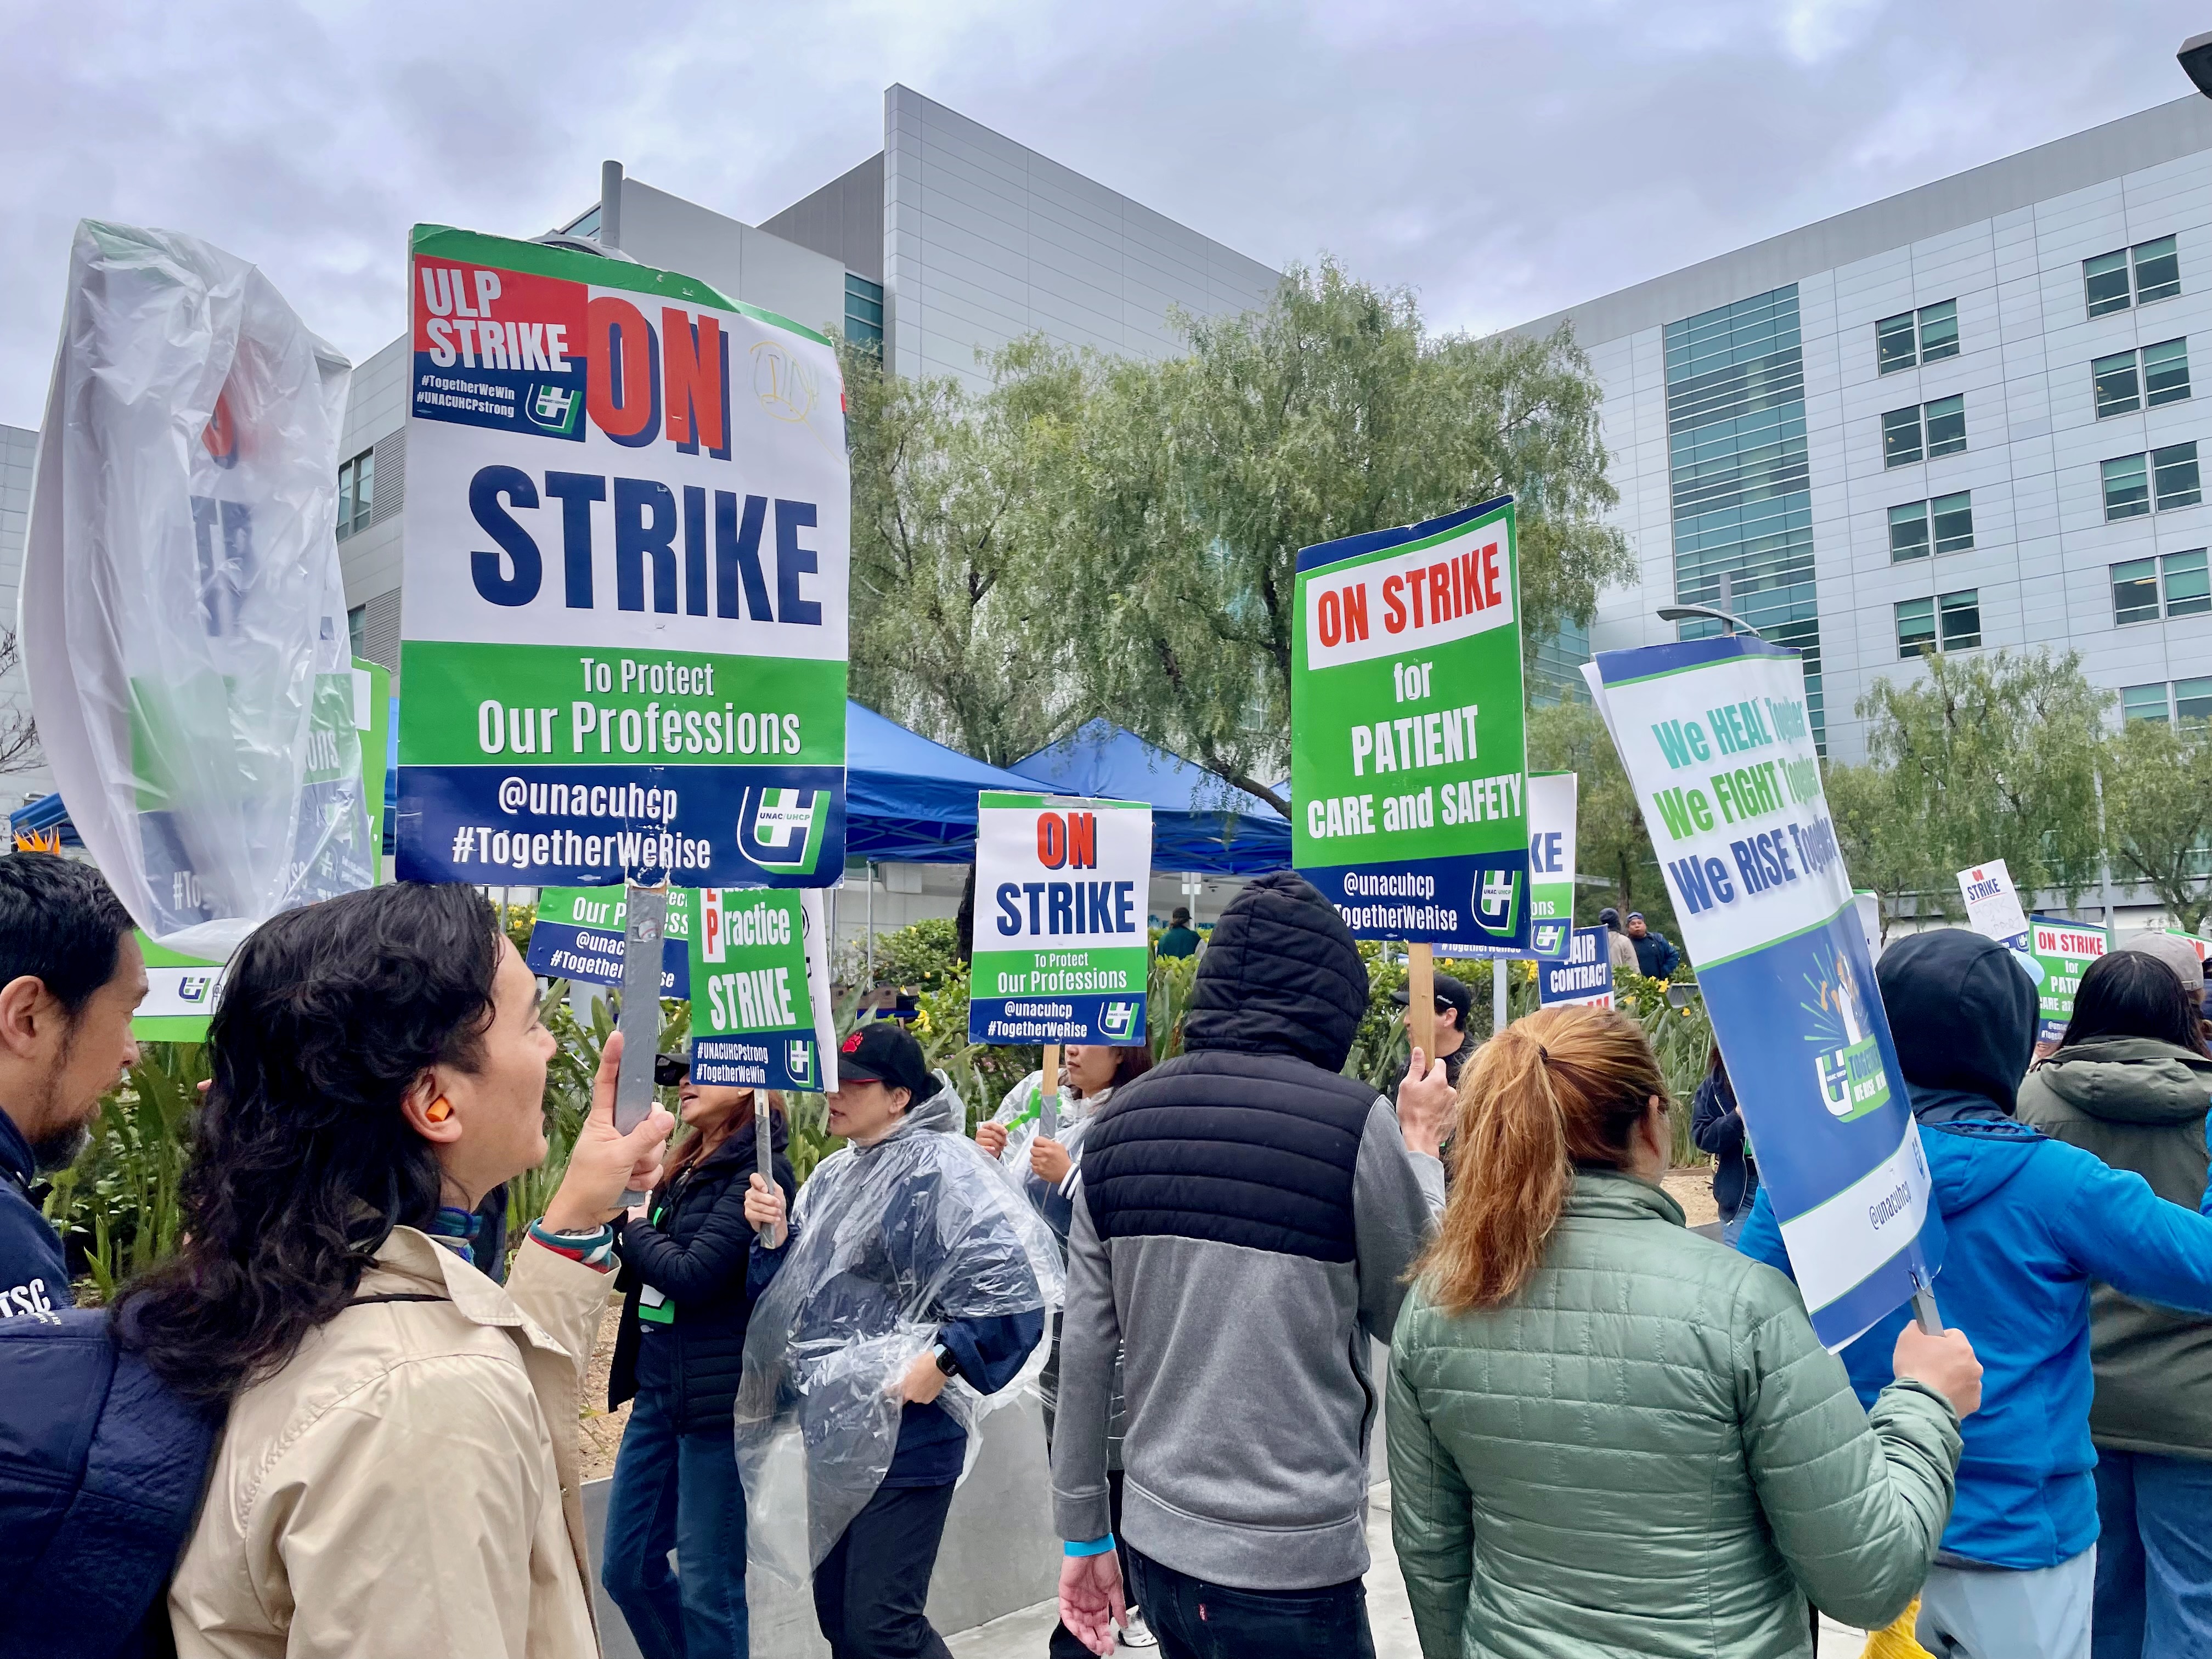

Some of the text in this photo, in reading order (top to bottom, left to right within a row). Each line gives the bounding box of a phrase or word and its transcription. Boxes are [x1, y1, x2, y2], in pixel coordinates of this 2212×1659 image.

[421, 267, 501, 318] ULP
[426, 318, 572, 372] STRIKE
[421, 375, 515, 400] #TogetherWeWin
[586, 296, 732, 461] ON
[416, 391, 515, 418] #UNACUHCPstrong
[469, 465, 822, 625] STRIKE
[1318, 542, 1502, 647] ON STRIKE
[580, 657, 715, 697] To Protect
[1393, 662, 1432, 703] for
[478, 699, 802, 755] Our Professions
[1351, 704, 1479, 776] PATIENT
[1651, 719, 1711, 769] We
[1706, 699, 1773, 755] HEAL
[499, 776, 678, 824] @unacuhcp
[1307, 772, 1522, 839] CARE and SAFETY
[1652, 787, 1714, 840] We
[1710, 760, 1784, 823] FIGHT
[453, 826, 712, 870] #TogetherWeRise
[1037, 812, 1097, 870] ON
[1344, 872, 1435, 900] @unacuhcp
[1667, 854, 1734, 915] We
[1730, 828, 1797, 895] RISE
[1967, 878, 2001, 900] STRIKE
[572, 897, 610, 924] Our
[996, 881, 1136, 936] STRIKE
[1334, 904, 1457, 931] TogetherWeRise
[576, 932, 625, 956] @unac
[1035, 952, 1088, 967] To Protect
[1565, 934, 1596, 965] AIR
[2039, 932, 2104, 956] ON STRIKE
[998, 968, 1127, 993] Our Professions
[1550, 963, 1607, 993] CONTRACT
[2051, 976, 2081, 994] PATI
[2065, 961, 2079, 974] for
[708, 967, 796, 1030] STRIKE
[1005, 1001, 1073, 1019] @unacuhcp
[988, 1020, 1087, 1037] #TogetherWeRise
[697, 1042, 769, 1064] #UNACUHCPstrong
[697, 1063, 765, 1084] #TogetherWeWin
[1869, 1181, 1912, 1230] @unacuhcp
